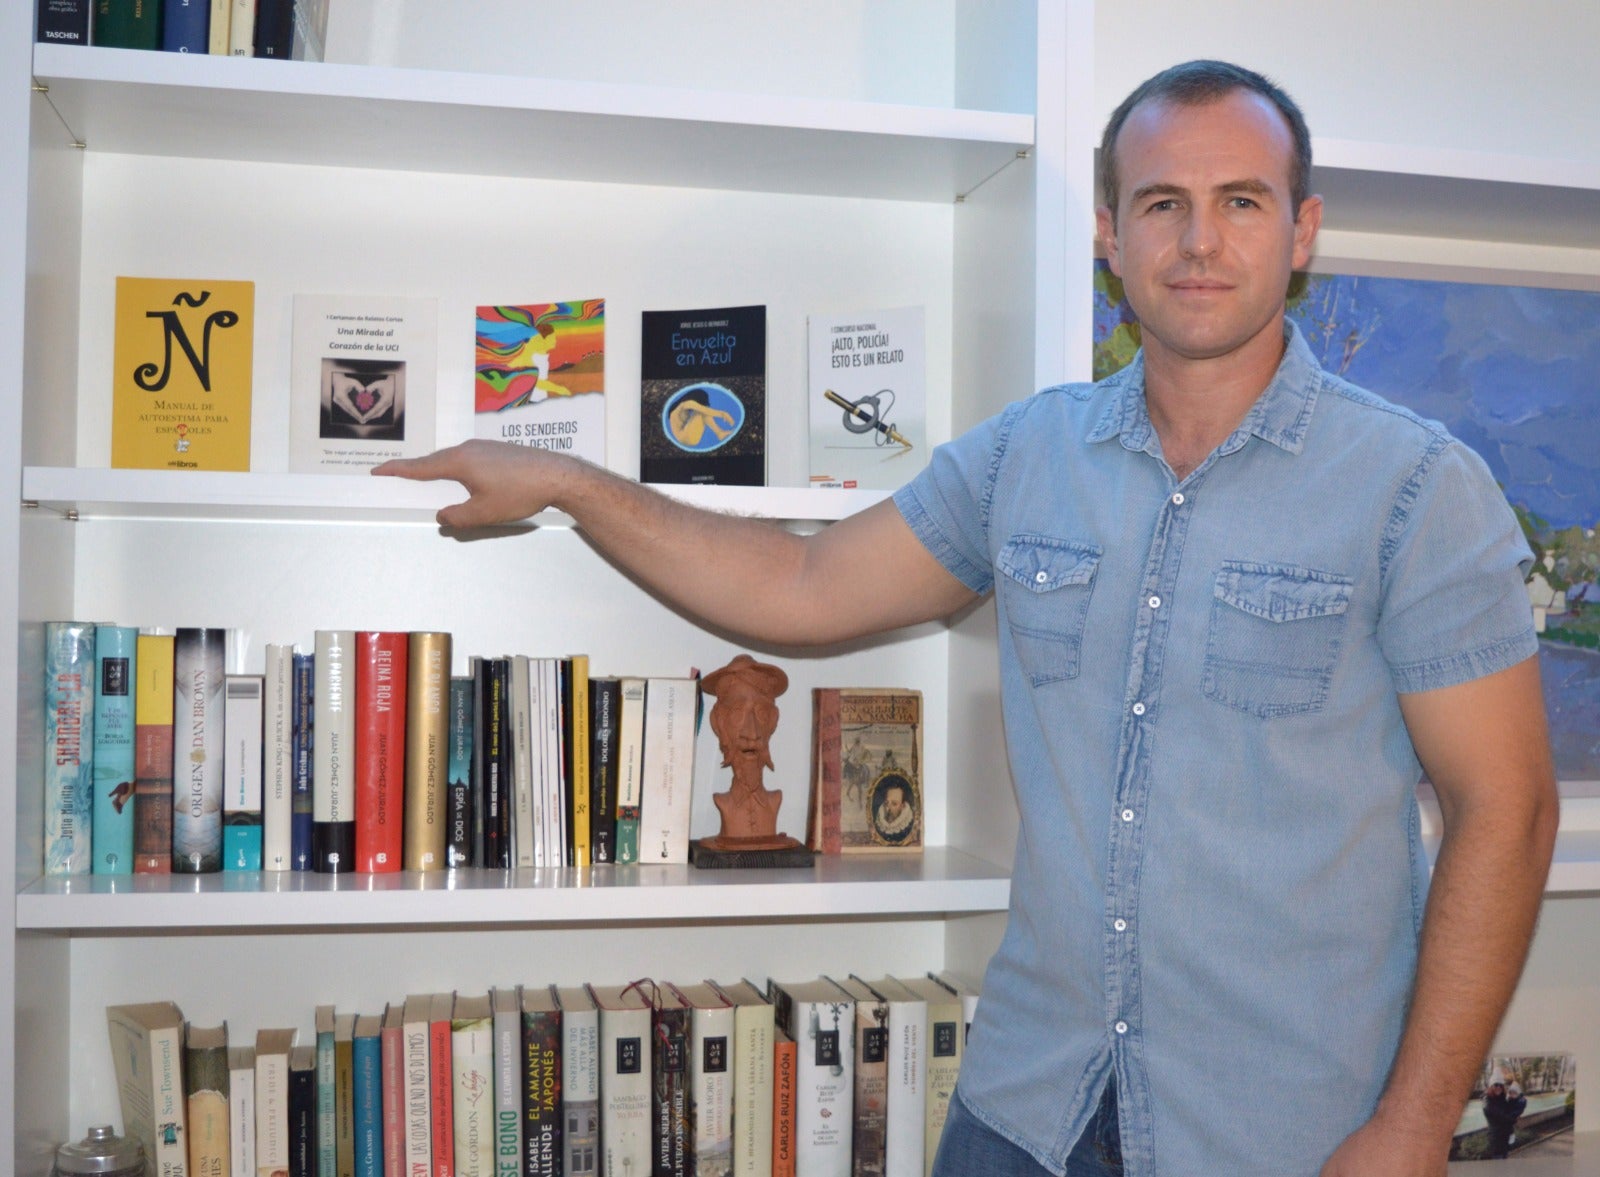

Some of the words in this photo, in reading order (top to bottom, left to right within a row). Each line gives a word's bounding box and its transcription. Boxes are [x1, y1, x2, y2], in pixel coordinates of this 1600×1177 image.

[46, 31, 79, 39] TASCHEN
[337, 328, 354, 336] Una
[355, 328, 385, 337] Mirada
[386, 329, 394, 337] al
[834, 325, 856, 333] CONCURSO
[856, 323, 877, 331] NACIONAL
[133, 291, 239, 392] Ñ
[329, 342, 362, 350] Corazón
[364, 343, 375, 351] de
[376, 343, 384, 351] la
[672, 331, 736, 350] Envuelta
[831, 336, 856, 354] ¡ALTO,
[857, 330, 889, 349] POLICÍA!
[675, 353, 695, 366] en
[700, 348, 732, 365] Azul
[831, 354, 850, 368] ESTO
[852, 353, 861, 367] ES
[863, 353, 875, 366] UN
[877, 349, 904, 365] RELATO
[138, 414, 201, 422] AUTOESTIMA
[205, 415, 229, 423] PARA
[201, 403, 215, 411] DE
[502, 424, 522, 437] LOS
[525, 421, 578, 437] SENDEROS
[530, 436, 573, 451] DESTINO
[377, 650, 392, 681] REINA
[427, 650, 441, 669] REY
[193, 670, 206, 717] BROWN
[328, 662, 342, 712] PACIENTE
[376, 685, 392, 713] ROJA
[426, 673, 441, 714] BLANCO
[456, 690, 464, 708] JUAN
[56, 672, 82, 767] SHANGRI-LA
[601, 691, 609, 728] REDONDO
[192, 721, 204, 748] DAN
[276, 720, 284, 743] BUICK
[331, 732, 339, 754] JUAN
[379, 732, 388, 755] JUAN
[456, 709, 464, 761] GÓMEZ-JURADO
[428, 733, 436, 755] JUAN
[601, 729, 609, 763] DOLORES
[299, 751, 307, 775] Grisham
[191, 764, 203, 818] ORIGEN
[275, 767, 283, 800] STEPHEN
[299, 776, 307, 790] John
[378, 757, 388, 825] GÓMEZ-JURADO
[427, 757, 436, 825] GÓMEZ-JURADO
[61, 784, 74, 815] Murillo
[455, 788, 465, 811] ESPÍA
[456, 812, 463, 820] DE
[61, 819, 74, 839] Julio
[455, 821, 465, 842] DIOS
[502, 1031, 512, 1056] SESIÓN
[569, 1027, 578, 1044] DEL
[580, 1027, 589, 1042] MÁS
[589, 1026, 597, 1056] ISABEL
[408, 1032, 425, 1068] DIJIMOS
[503, 1057, 512, 1065] LA
[580, 1046, 589, 1073] ALLÁ
[159, 1040, 172, 1093] Townsend
[409, 1070, 426, 1087] NOS
[529, 1043, 540, 1101] AMANTE
[569, 1046, 578, 1091] INVIERNO
[588, 1057, 596, 1096] ALLENDE
[779, 1053, 790, 1090] ZAFÓN
[503, 1067, 512, 1095] LEVANTA
[541, 1050, 553, 1111] JAPONÉS
[705, 1077, 714, 1106] MORO
[748, 1086, 755, 1096] LA
[162, 1095, 173, 1115] Sue
[409, 1088, 426, 1101] NO
[503, 1095, 512, 1105] SE
[748, 1100, 755, 1109] DE
[780, 1092, 790, 1116] RUIZ
[410, 1102, 428, 1117] QUE
[529, 1105, 540, 1120] EL
[661, 1101, 669, 1135] SIERRA
[675, 1089, 684, 1134] INVISIBLE
[410, 1119, 428, 1141] COSAS
[499, 1111, 518, 1156] BONO
[705, 1107, 714, 1137] JAVIER
[468, 1111, 479, 1162] GORDON
[779, 1119, 790, 1161] CARLOS
[411, 1143, 428, 1156] LAS
[529, 1136, 539, 1173] ISABEL
[661, 1137, 671, 1169] JAVIER
[676, 1136, 684, 1168] FUEGO
